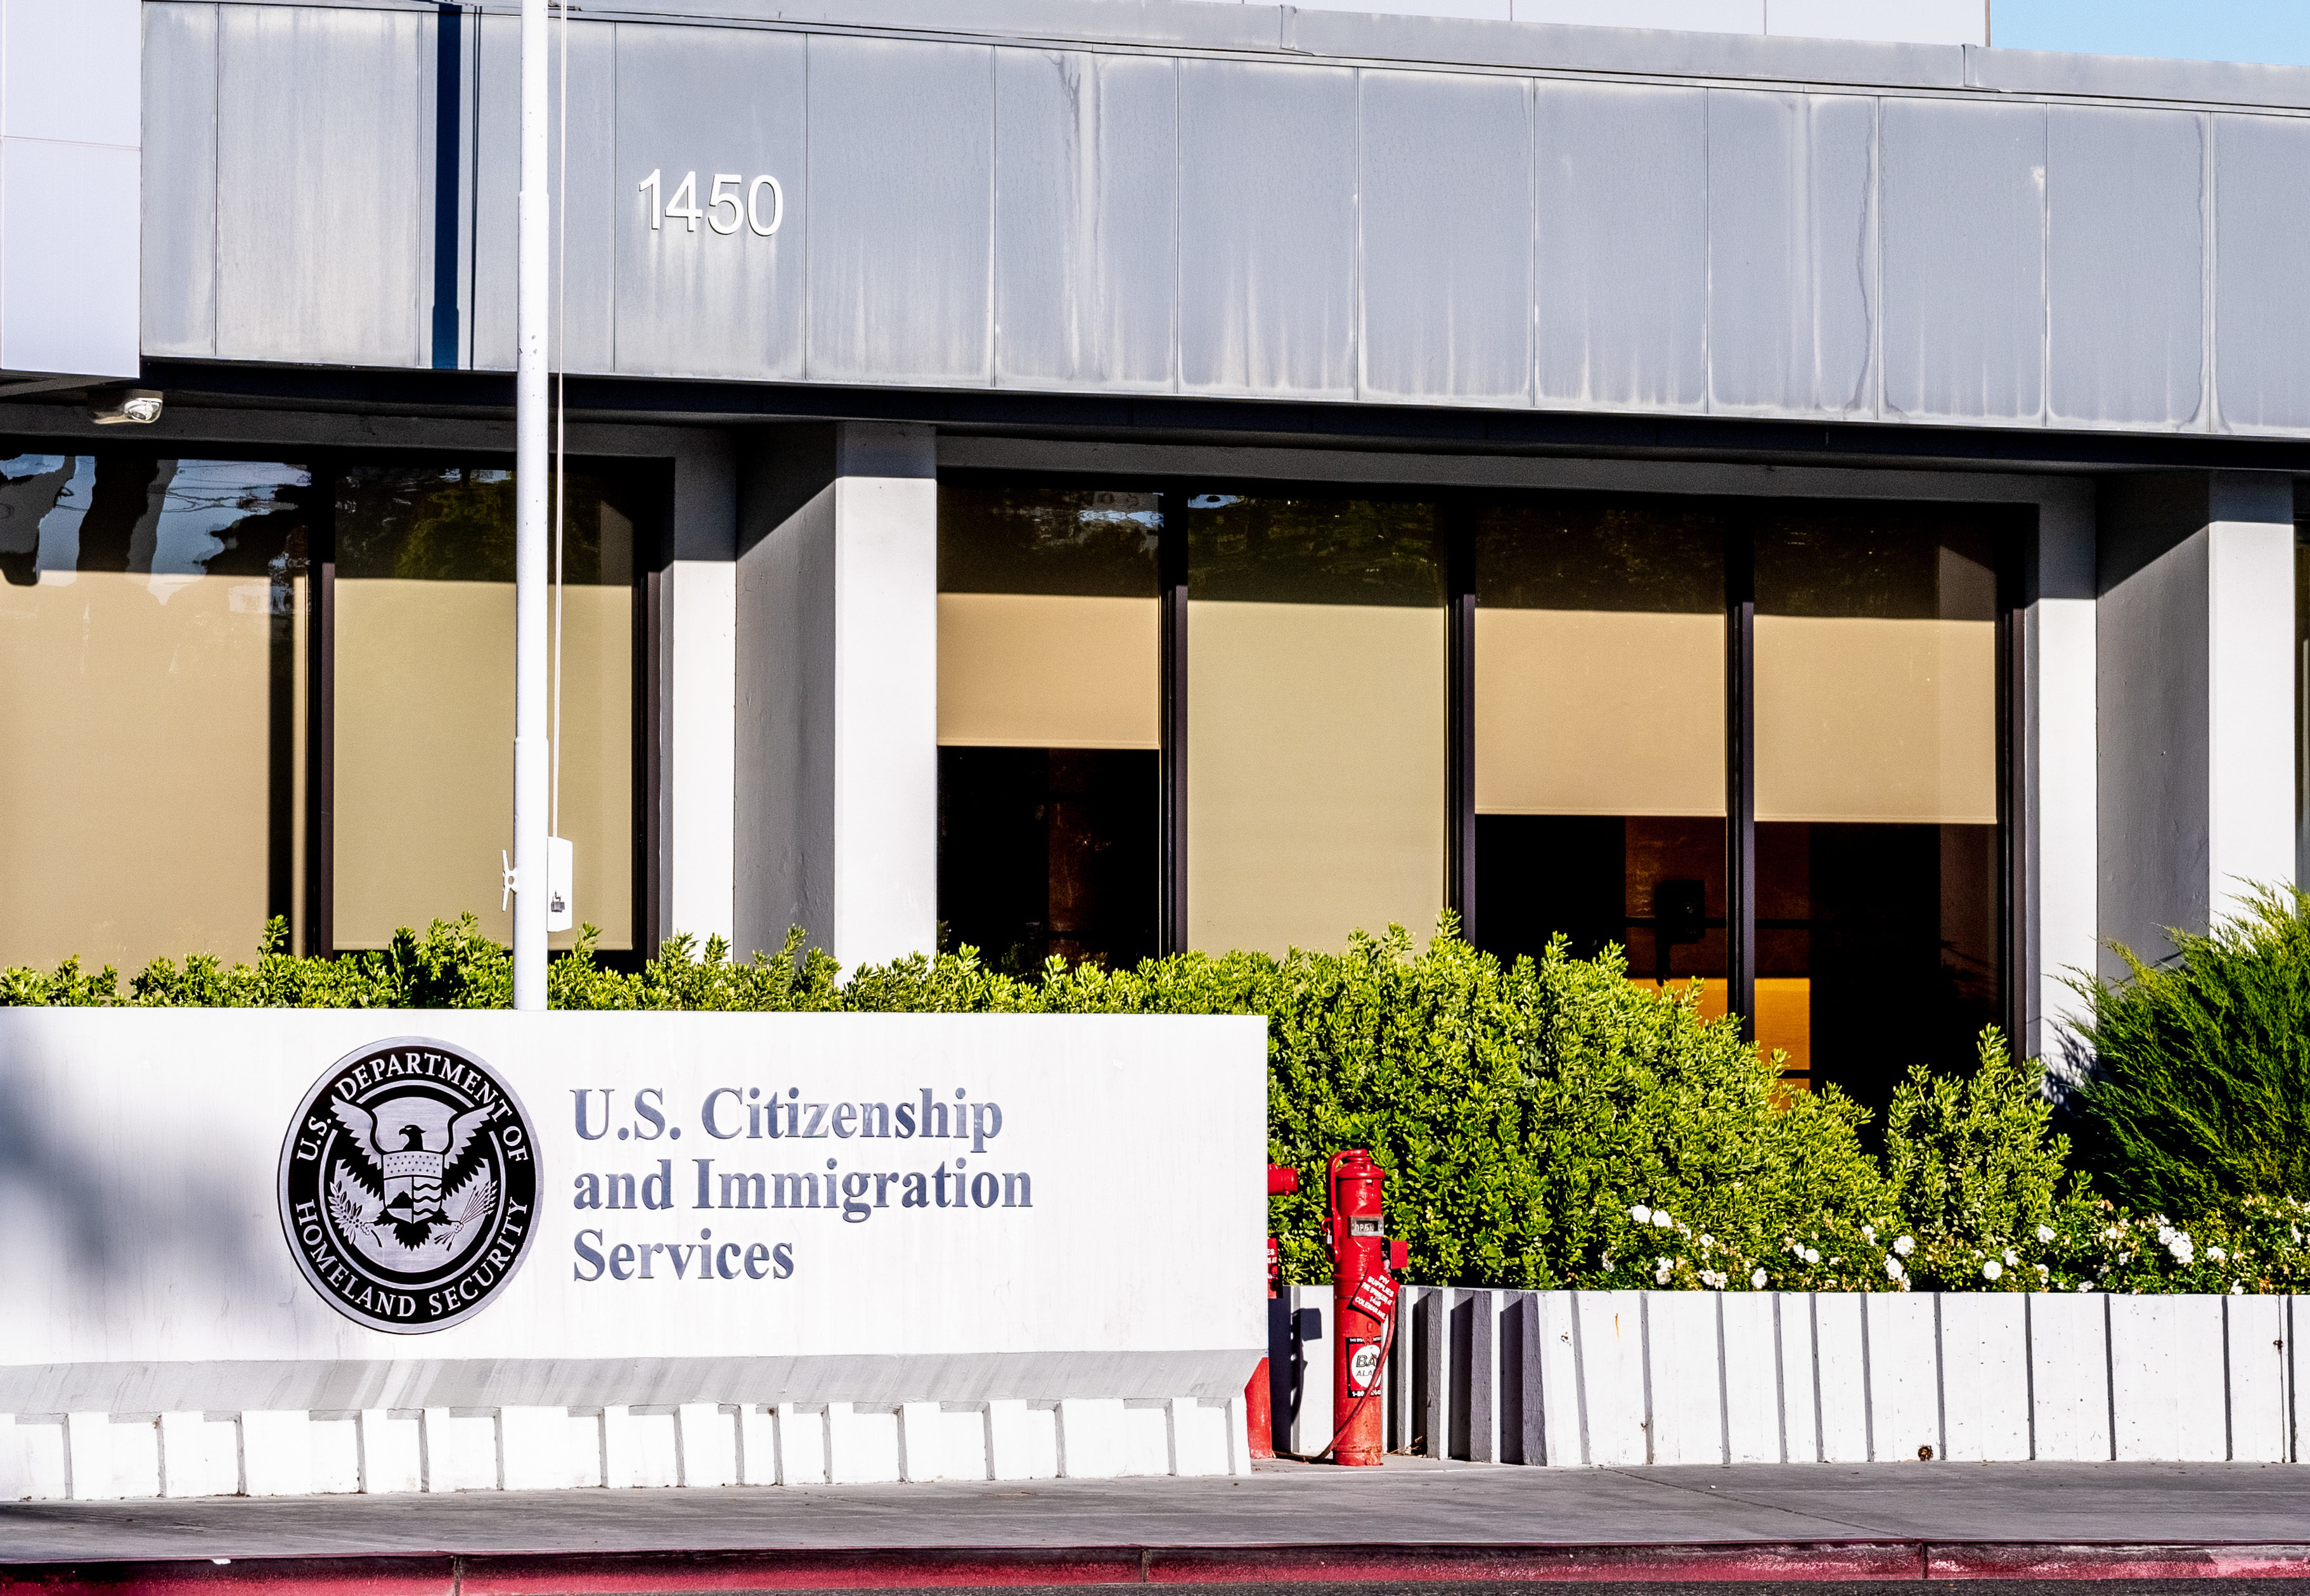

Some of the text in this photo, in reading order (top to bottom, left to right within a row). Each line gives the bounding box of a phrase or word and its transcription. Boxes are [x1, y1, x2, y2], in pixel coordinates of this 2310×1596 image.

[639, 169, 784, 237] 1450
[296, 1053, 529, 1162] U.S. DEPARTMENT OF
[569, 1087, 1003, 1153] U.S. Citizenship
[574, 1157, 1033, 1223] and Immigration
[295, 1197, 528, 1316] HOMELAND SECURITY
[574, 1228, 794, 1282] Services
[1367, 1276, 1395, 1297] SUPPLIES
[1356, 1355, 1378, 1367] BA
